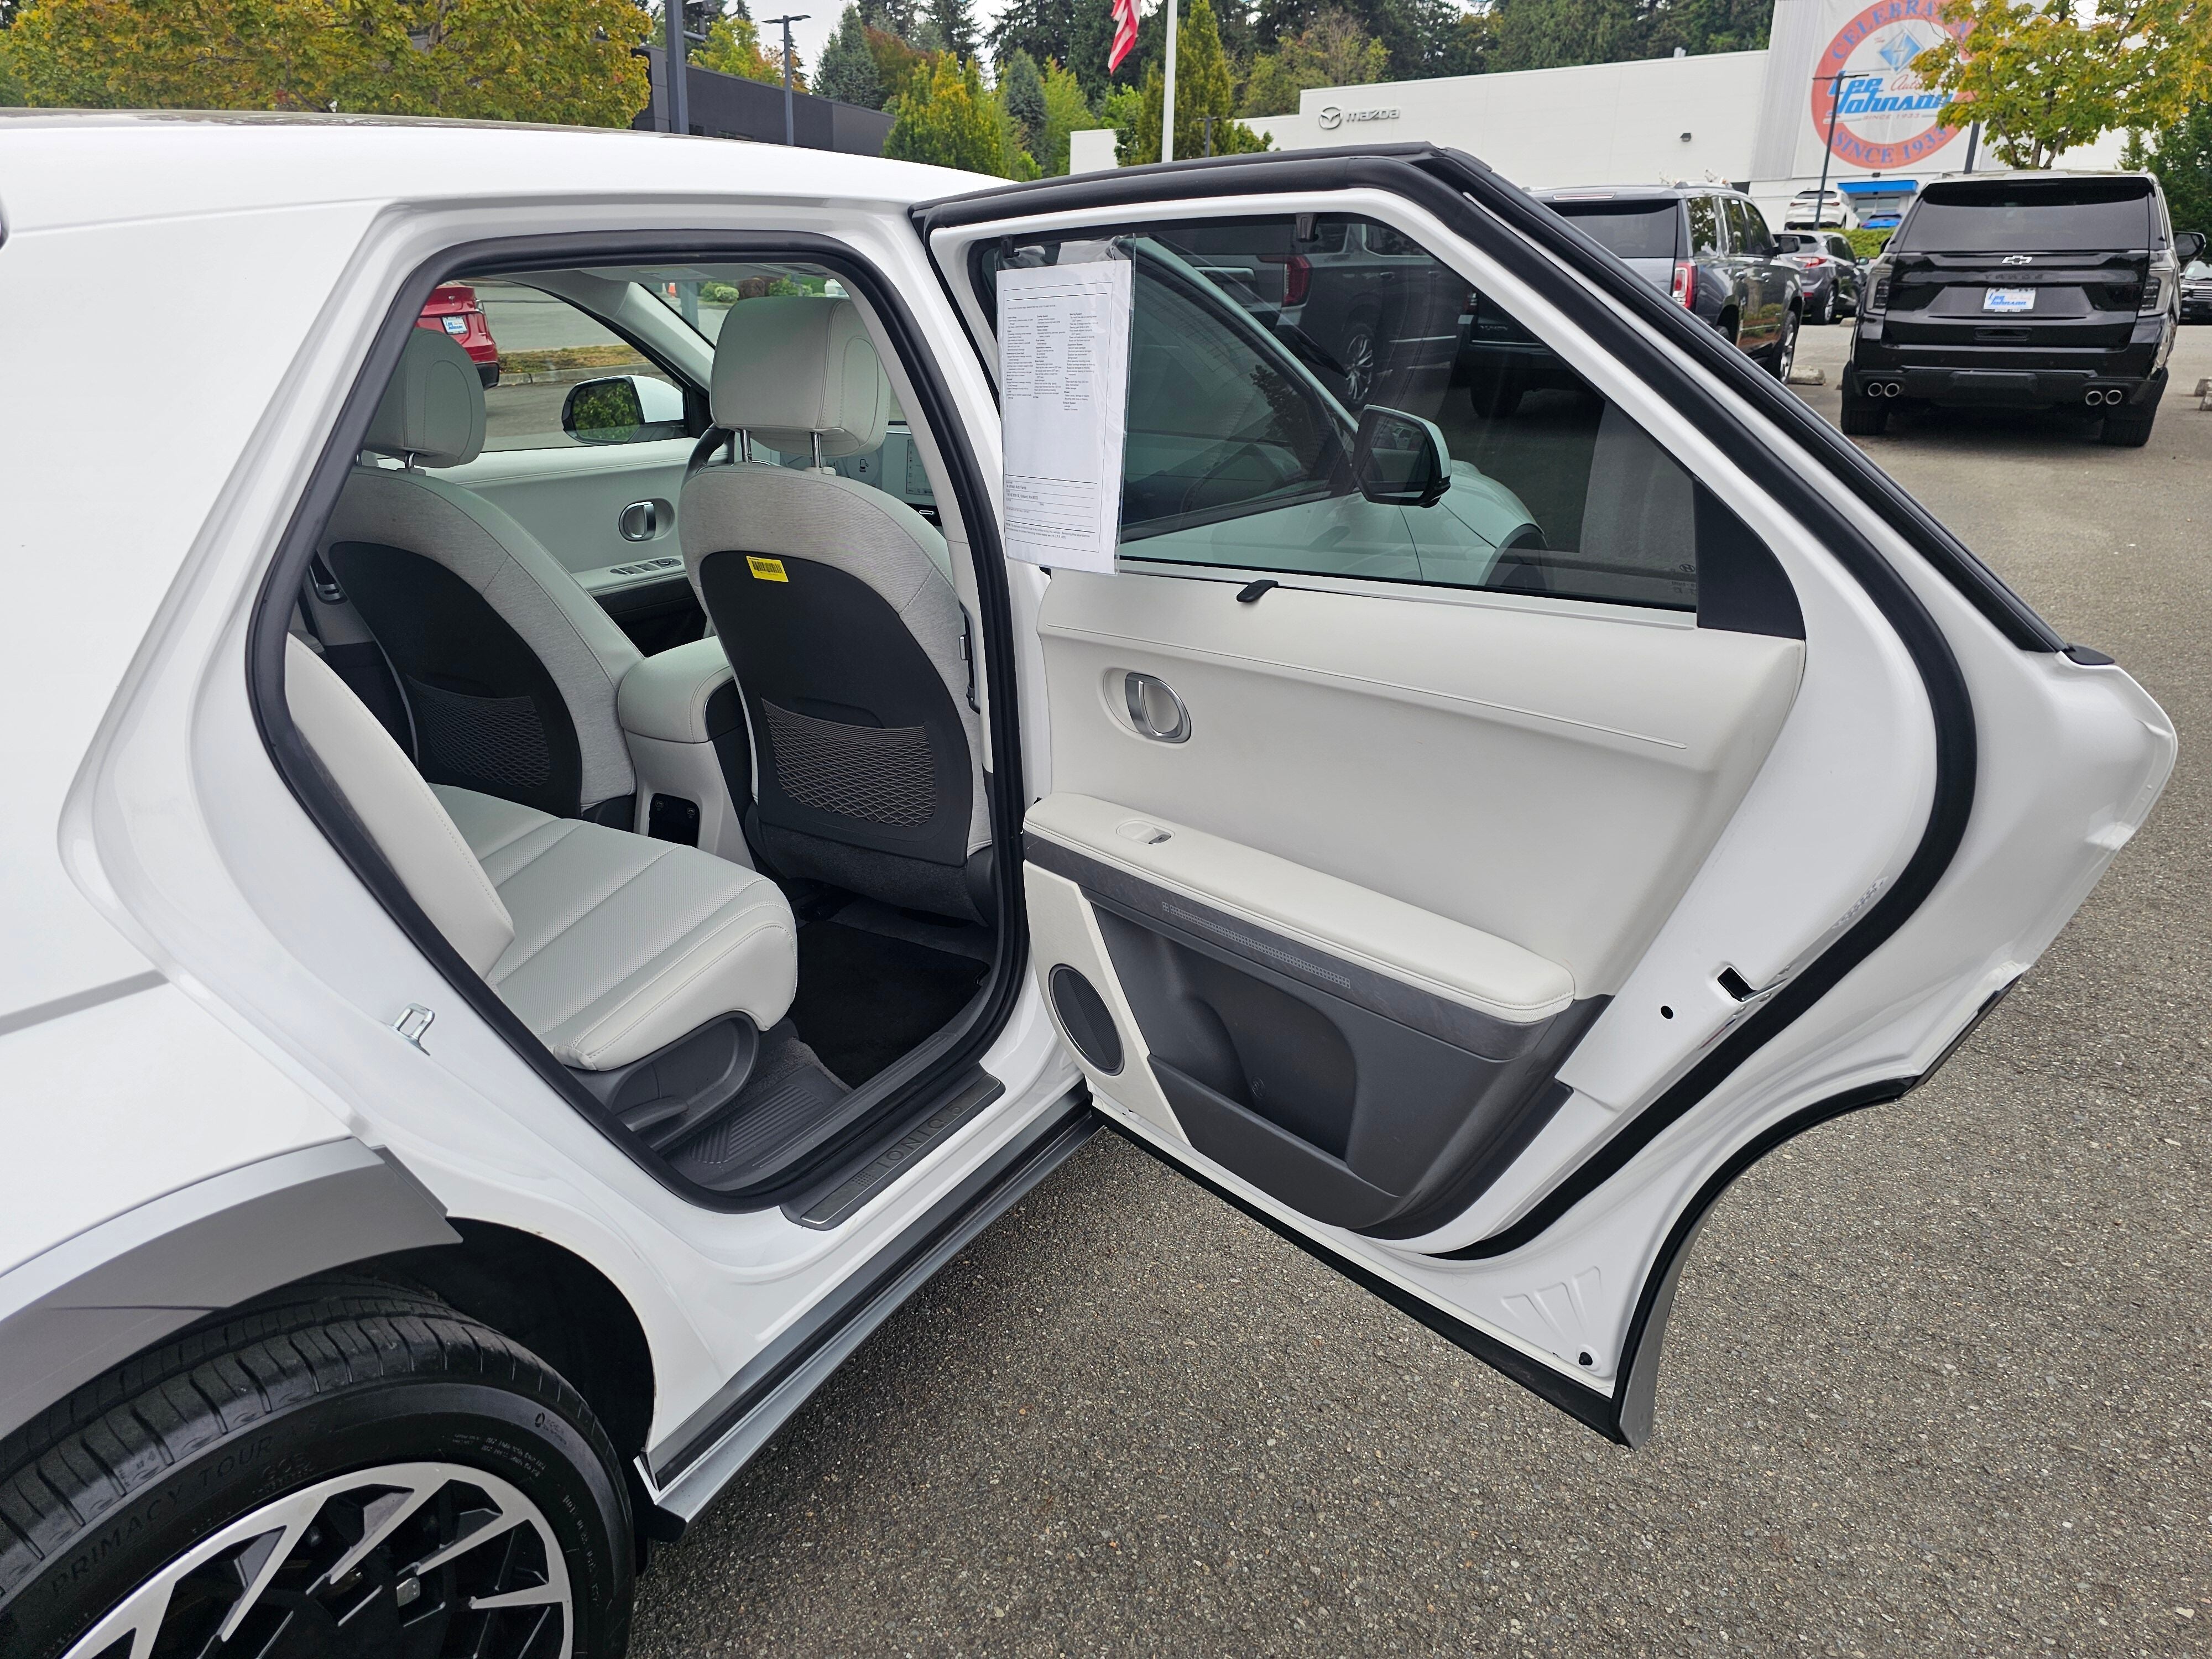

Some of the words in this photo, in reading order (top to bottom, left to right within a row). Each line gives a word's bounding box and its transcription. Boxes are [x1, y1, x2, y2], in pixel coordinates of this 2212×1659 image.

[1827, 70, 1884, 96] Lee
[1345, 109, 1400, 122] mazda
[1827, 88, 1954, 114] Johnson
[1832, 129, 1895, 164] SINCE
[1903, 127, 1948, 160] 1933
[876, 1119, 947, 1168] IONIQ
[946, 1104, 963, 1115] 5
[51, 1483, 183, 1597] PRIMACY
[199, 1436, 272, 1486] TOUR
